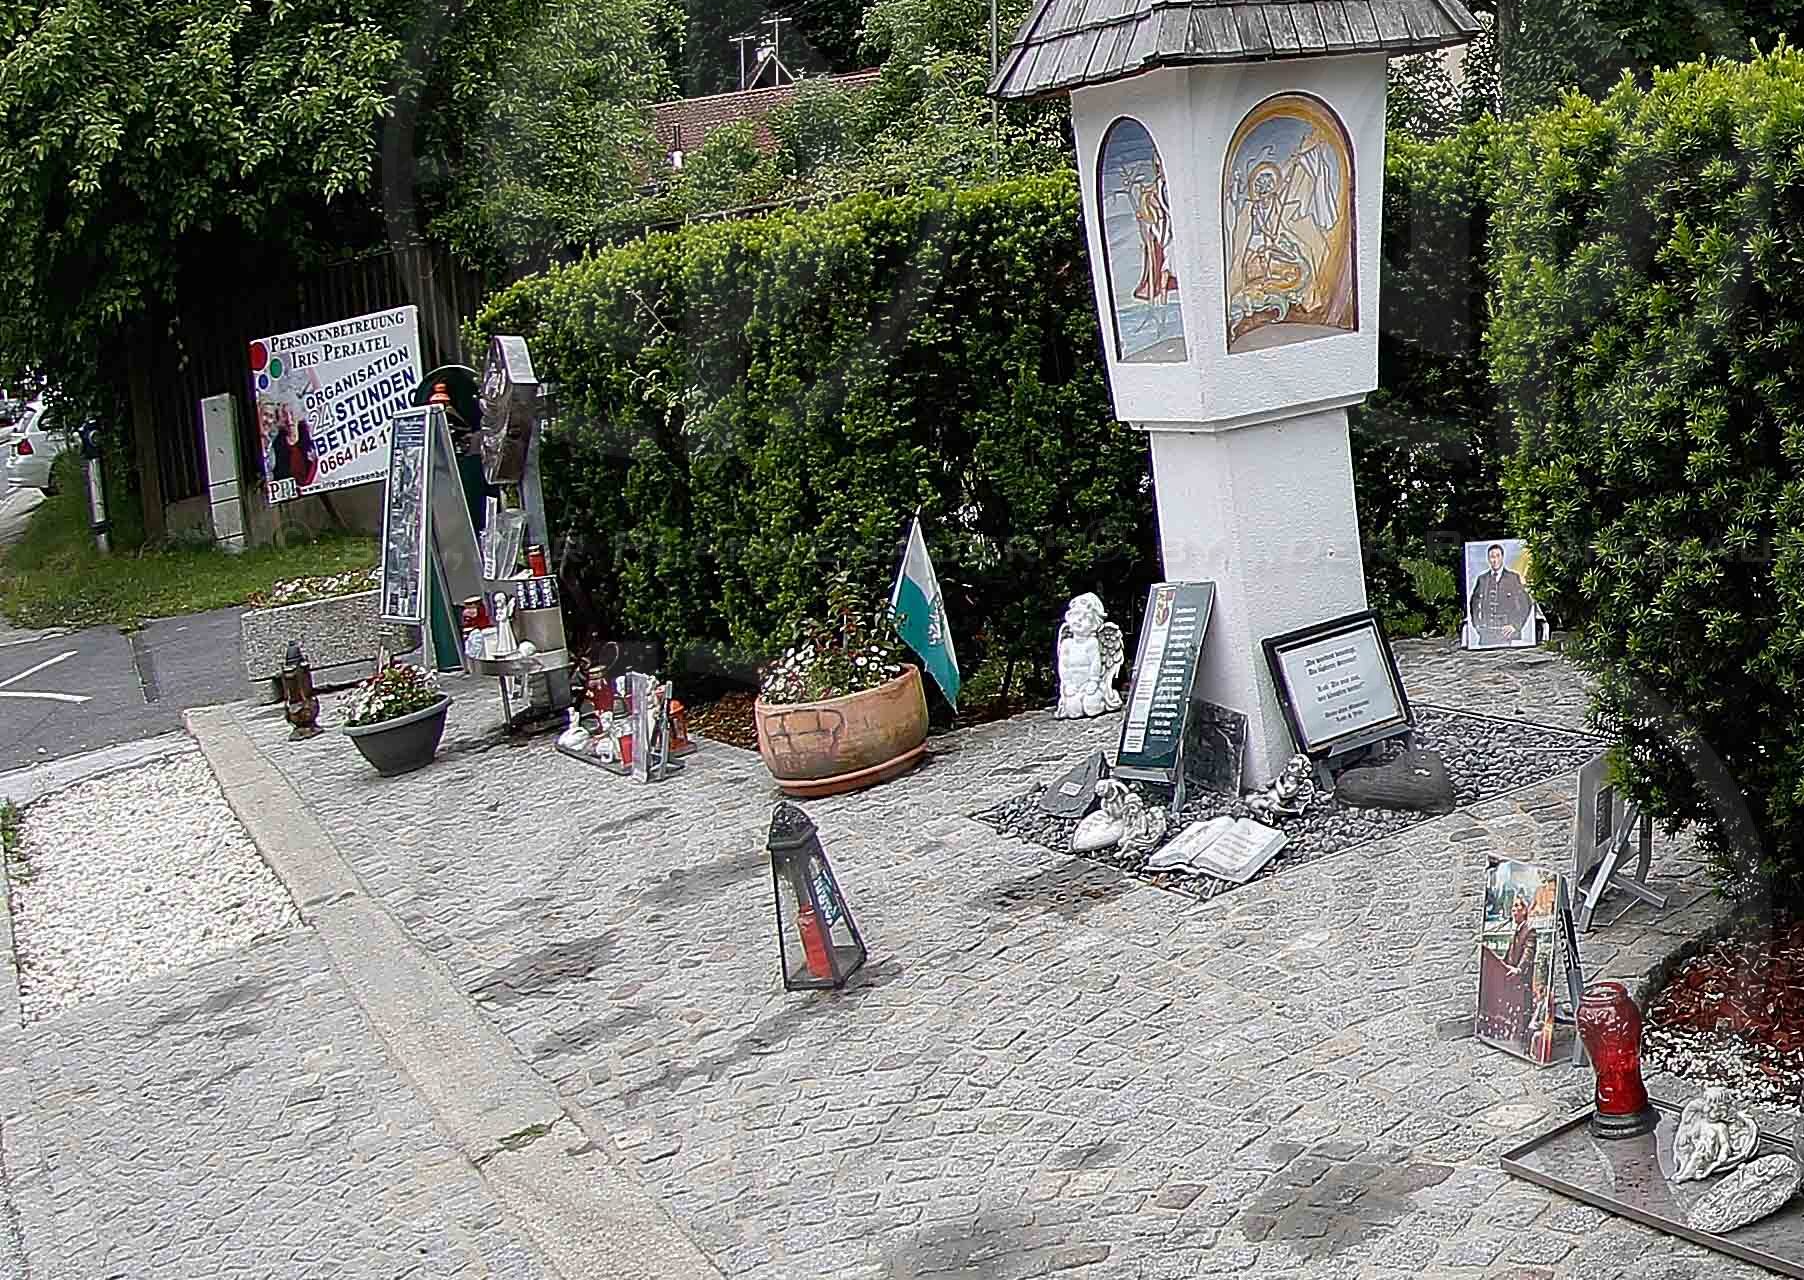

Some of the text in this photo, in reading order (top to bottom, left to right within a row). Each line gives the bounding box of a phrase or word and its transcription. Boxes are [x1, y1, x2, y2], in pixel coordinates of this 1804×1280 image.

[271, 312, 404, 352] PERSONENBETREUUNG
[291, 335, 391, 368] IRIS PERJATEL
[306, 346, 410, 410] ORGANISATION
[309, 366, 416, 436] 24 STUNDEN
